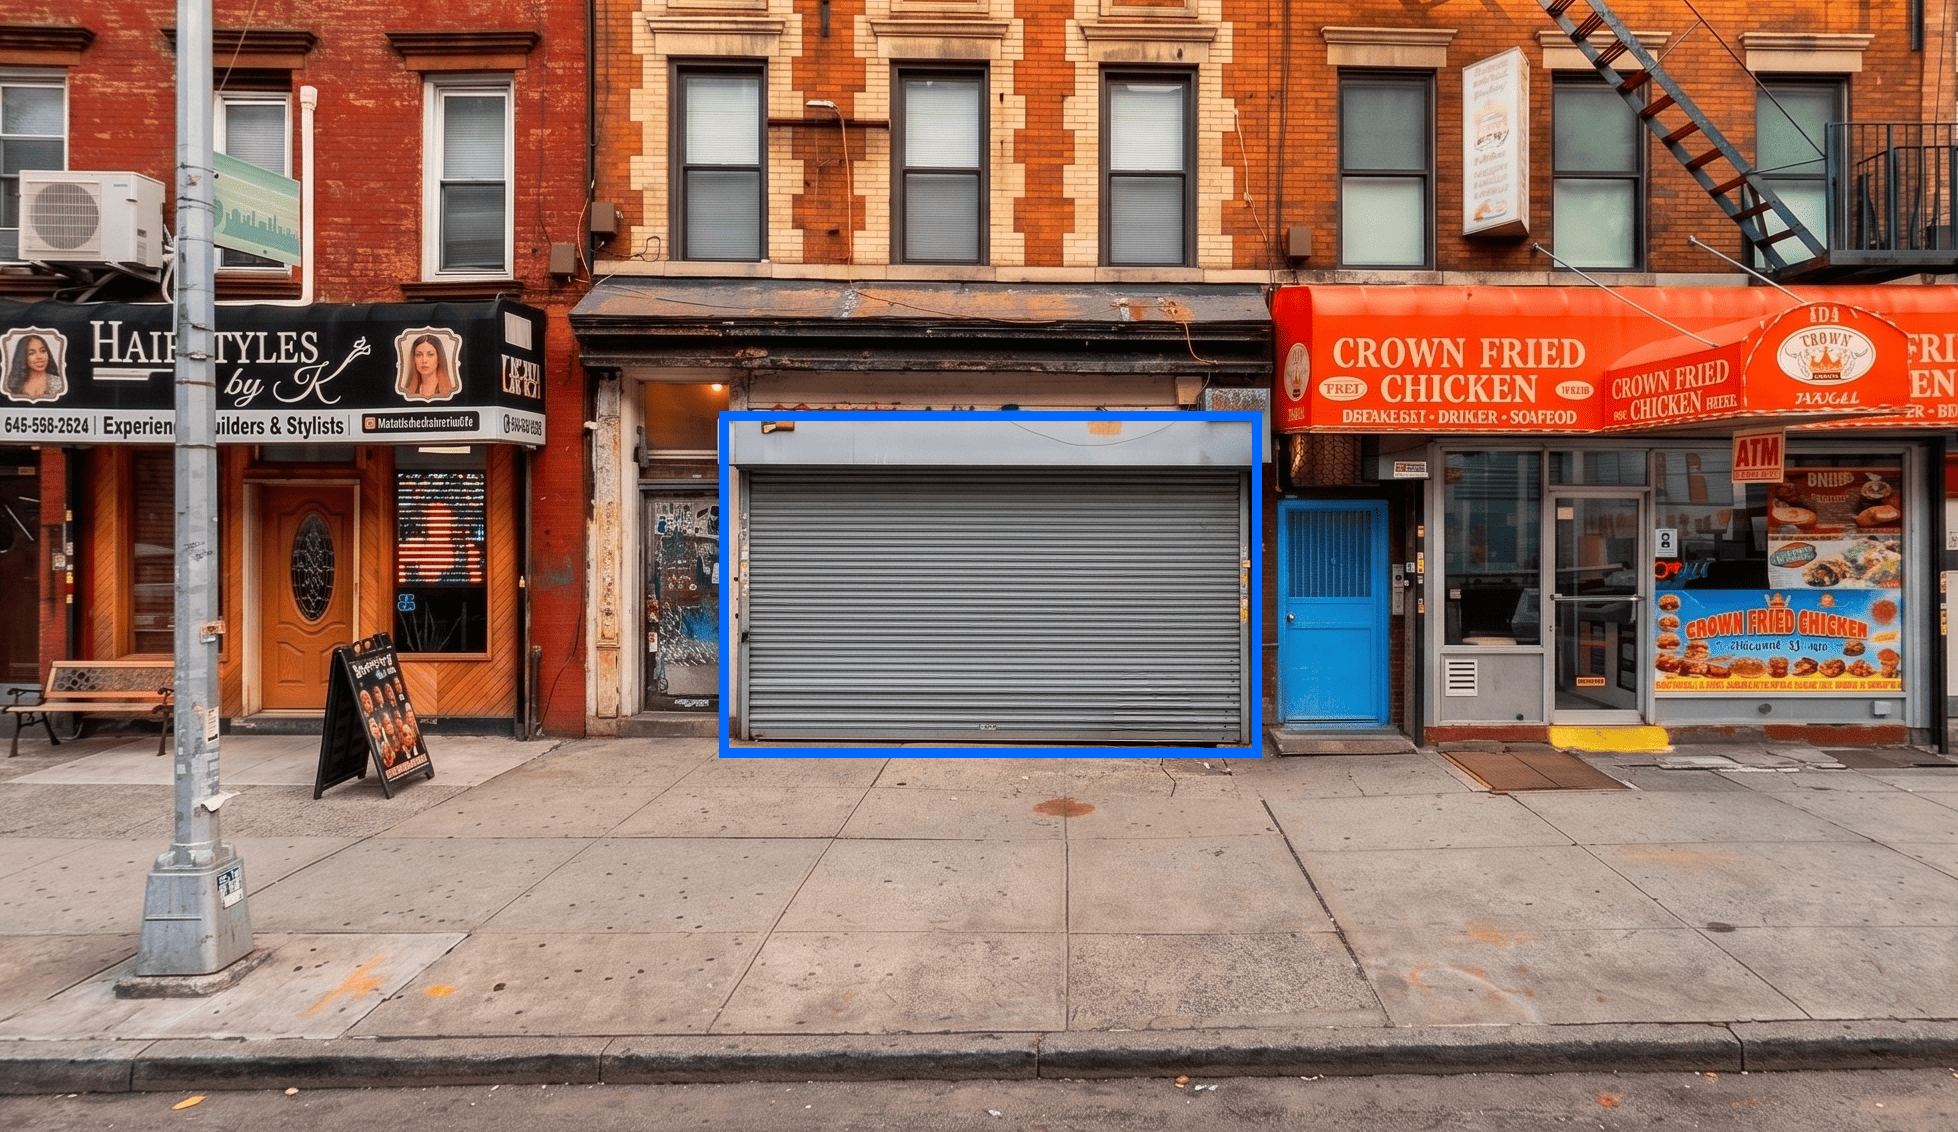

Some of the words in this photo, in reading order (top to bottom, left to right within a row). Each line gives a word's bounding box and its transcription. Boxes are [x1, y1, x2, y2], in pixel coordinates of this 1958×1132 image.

[214, 331, 319, 363] TYLES
[1332, 337, 1467, 369] CROWN
[1479, 337, 1587, 369] FRIED
[1907, 333, 1958, 363] FRI
[223, 368, 265, 407] by
[1379, 374, 1539, 404] CHICKEN
[1612, 369, 1670, 400] CROWN
[1674, 359, 1730, 391] FRIED
[1909, 369, 1958, 398] EN
[1630, 390, 1703, 421] CHICKEN
[103, 415, 176, 440] Experien
[215, 416, 265, 435] uilders
[269, 416, 282, 435] &
[287, 415, 344, 440] Stylists
[1735, 437, 1779, 468] ATM
[1685, 611, 1745, 640] CROWN
[1747, 608, 1796, 635] FRIED
[1797, 609, 1869, 640] CHICKEN
